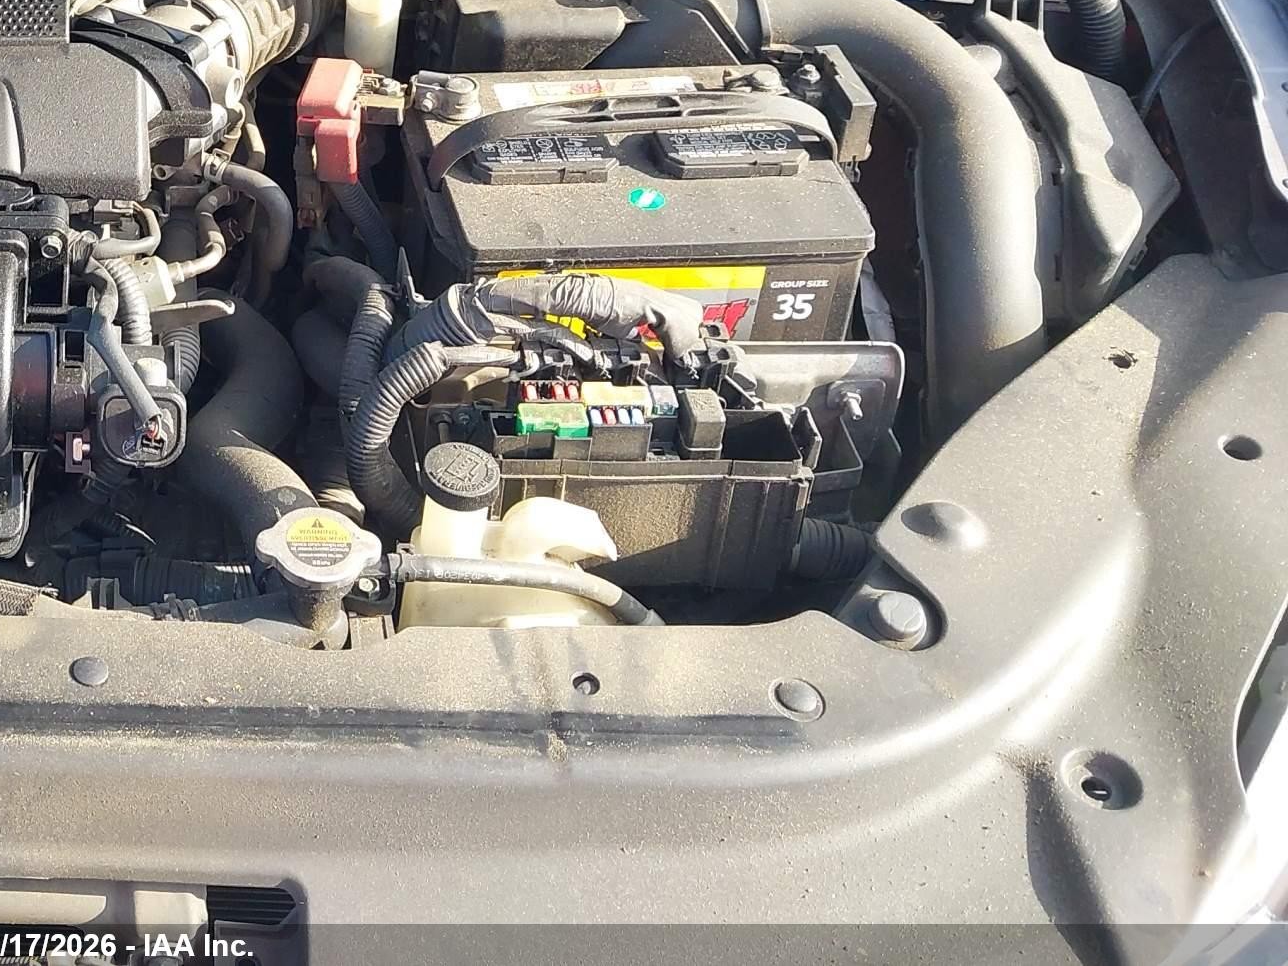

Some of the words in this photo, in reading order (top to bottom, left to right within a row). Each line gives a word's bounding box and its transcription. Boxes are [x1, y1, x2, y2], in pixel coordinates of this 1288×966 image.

[770, 280, 805, 289] GROUP
[806, 279, 829, 288] SIZE
[772, 293, 815, 320] 35
